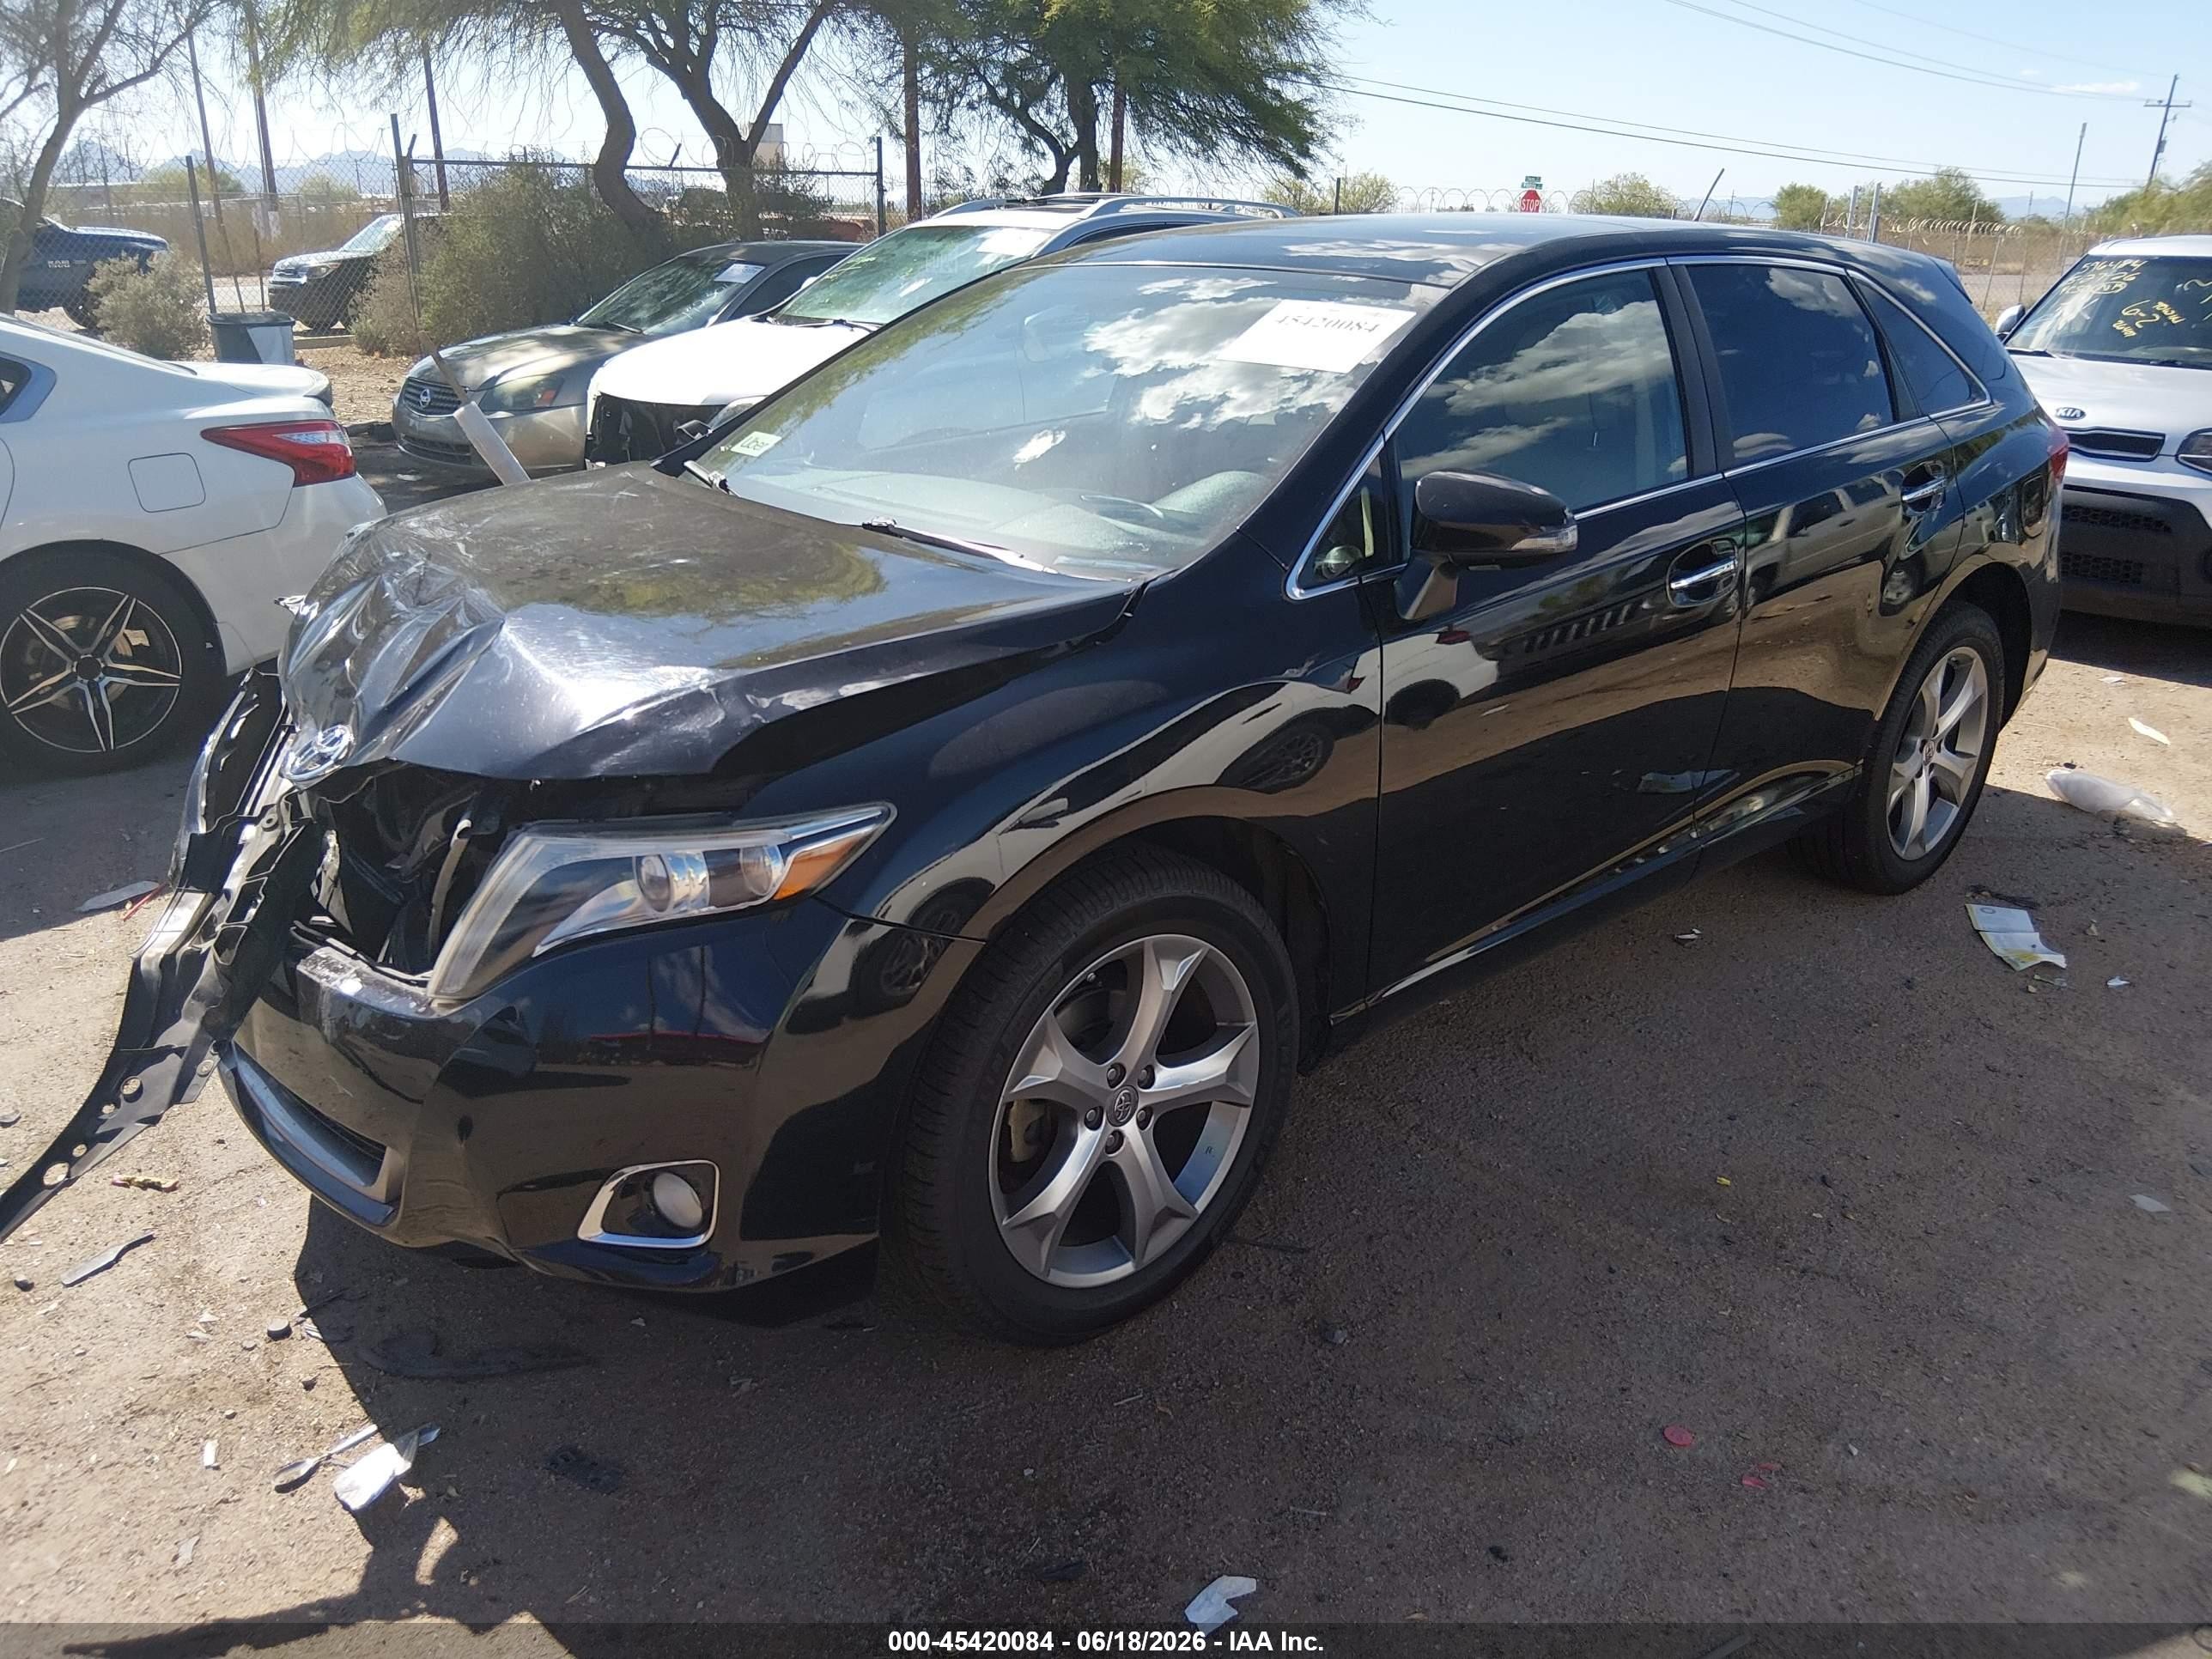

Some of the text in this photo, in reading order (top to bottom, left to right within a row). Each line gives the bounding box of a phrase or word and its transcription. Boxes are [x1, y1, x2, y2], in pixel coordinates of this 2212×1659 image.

[1521, 198, 1540, 211] STOP
[2121, 300, 2160, 329] 6-2
[2056, 408, 2081, 418] KIA
